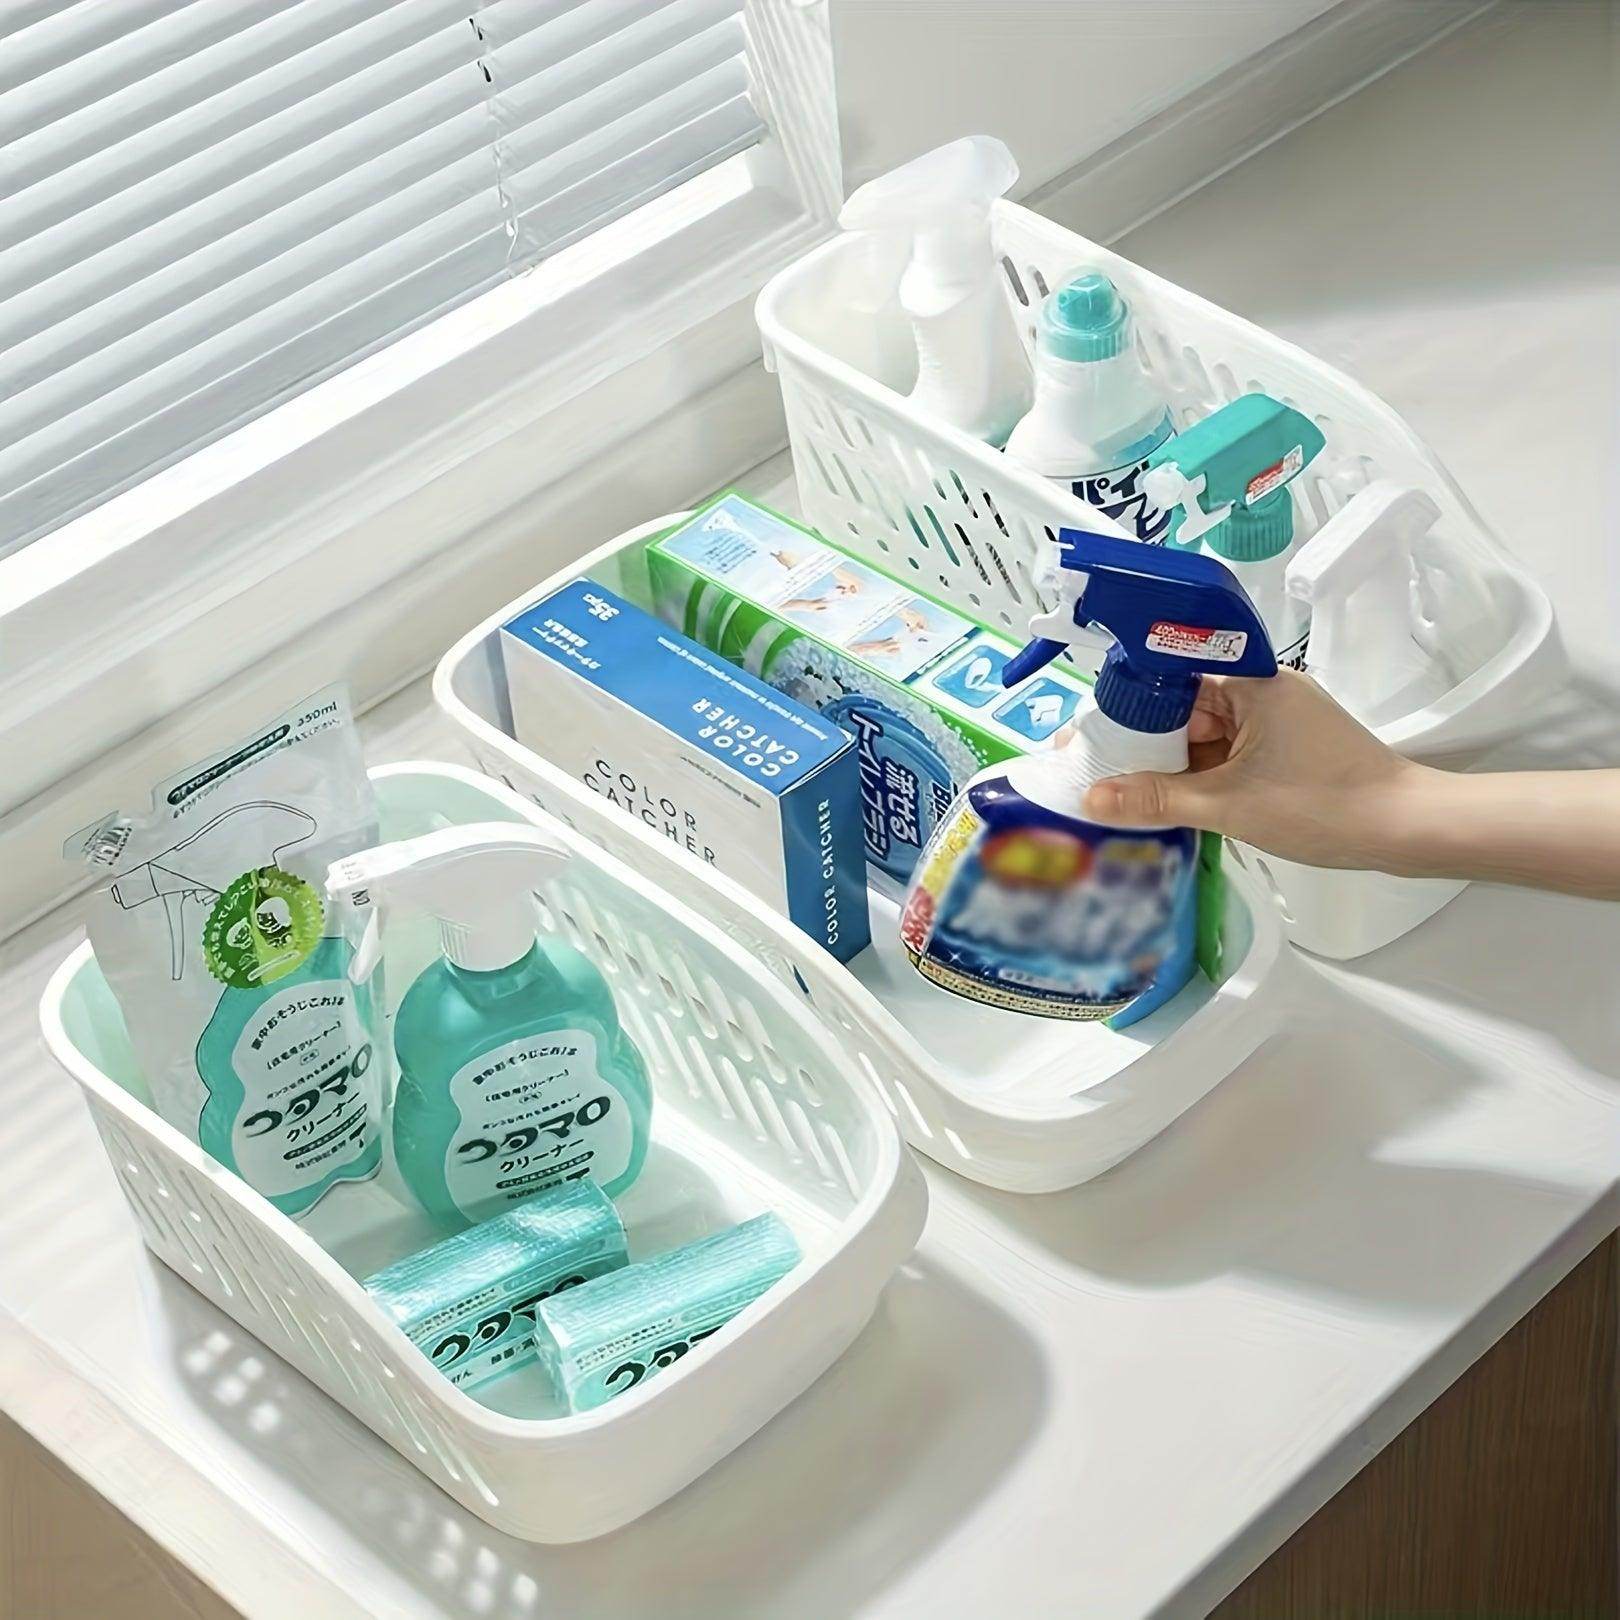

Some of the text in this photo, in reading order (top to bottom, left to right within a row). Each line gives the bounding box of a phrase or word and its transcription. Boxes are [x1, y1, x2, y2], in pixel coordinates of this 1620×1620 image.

[691, 698, 799, 765] CATCHER
[698, 725, 781, 777] COLOR
[583, 773, 716, 866] CATCHER
[596, 760, 697, 831] COLOR
[885, 761, 919, 846] 流せる
[818, 799, 838, 944] COLOR CATCHER
[286, 1092, 360, 1142] クリーナー
[500, 1138, 584, 1174] クリーナー
